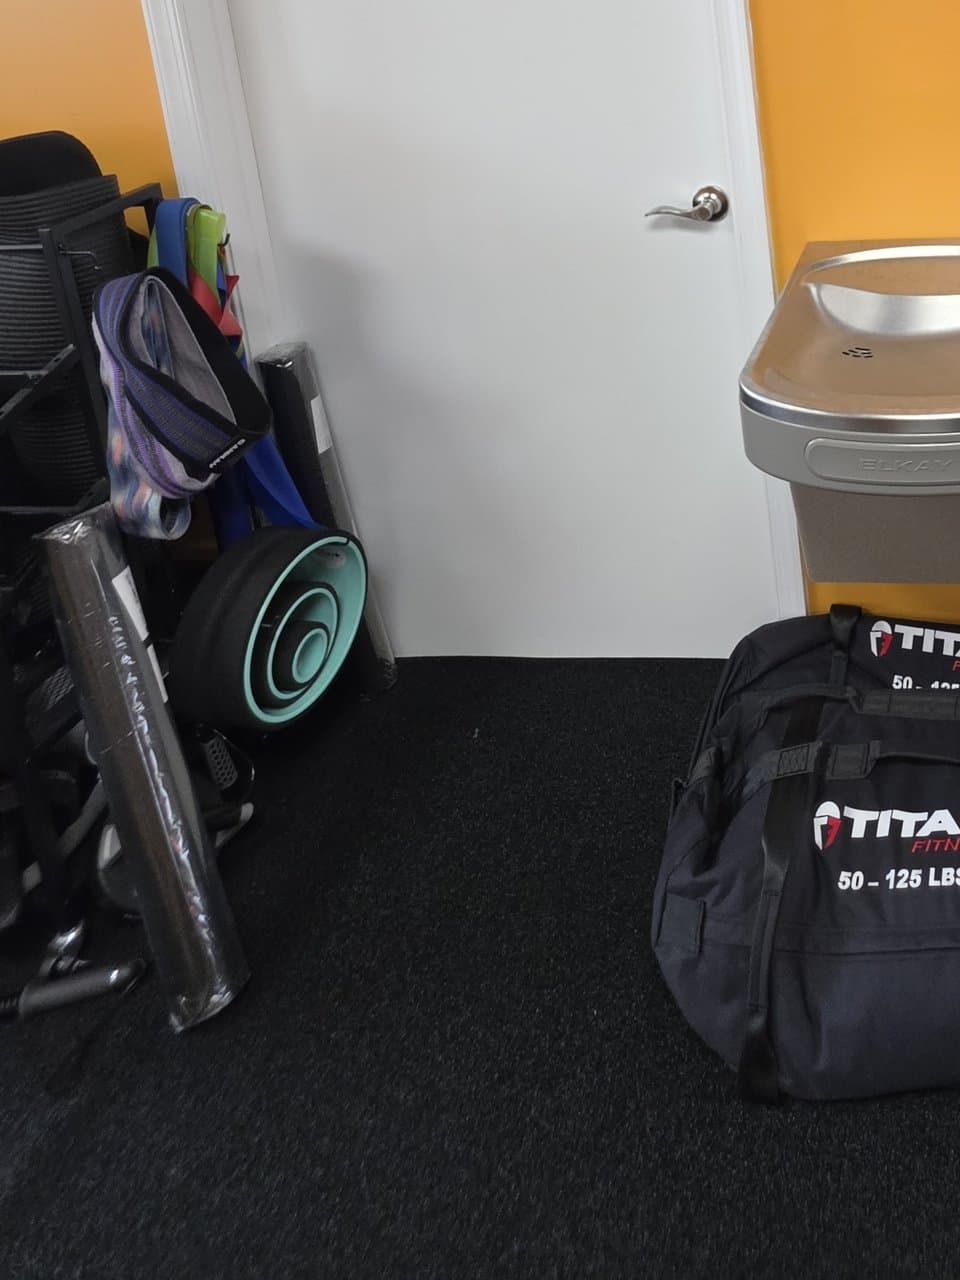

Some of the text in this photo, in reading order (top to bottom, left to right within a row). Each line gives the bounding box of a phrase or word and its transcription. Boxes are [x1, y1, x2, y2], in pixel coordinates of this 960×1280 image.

[860, 458, 953, 473] ELKAY
[838, 871, 864, 890] 50
[885, 869, 922, 889] 125
